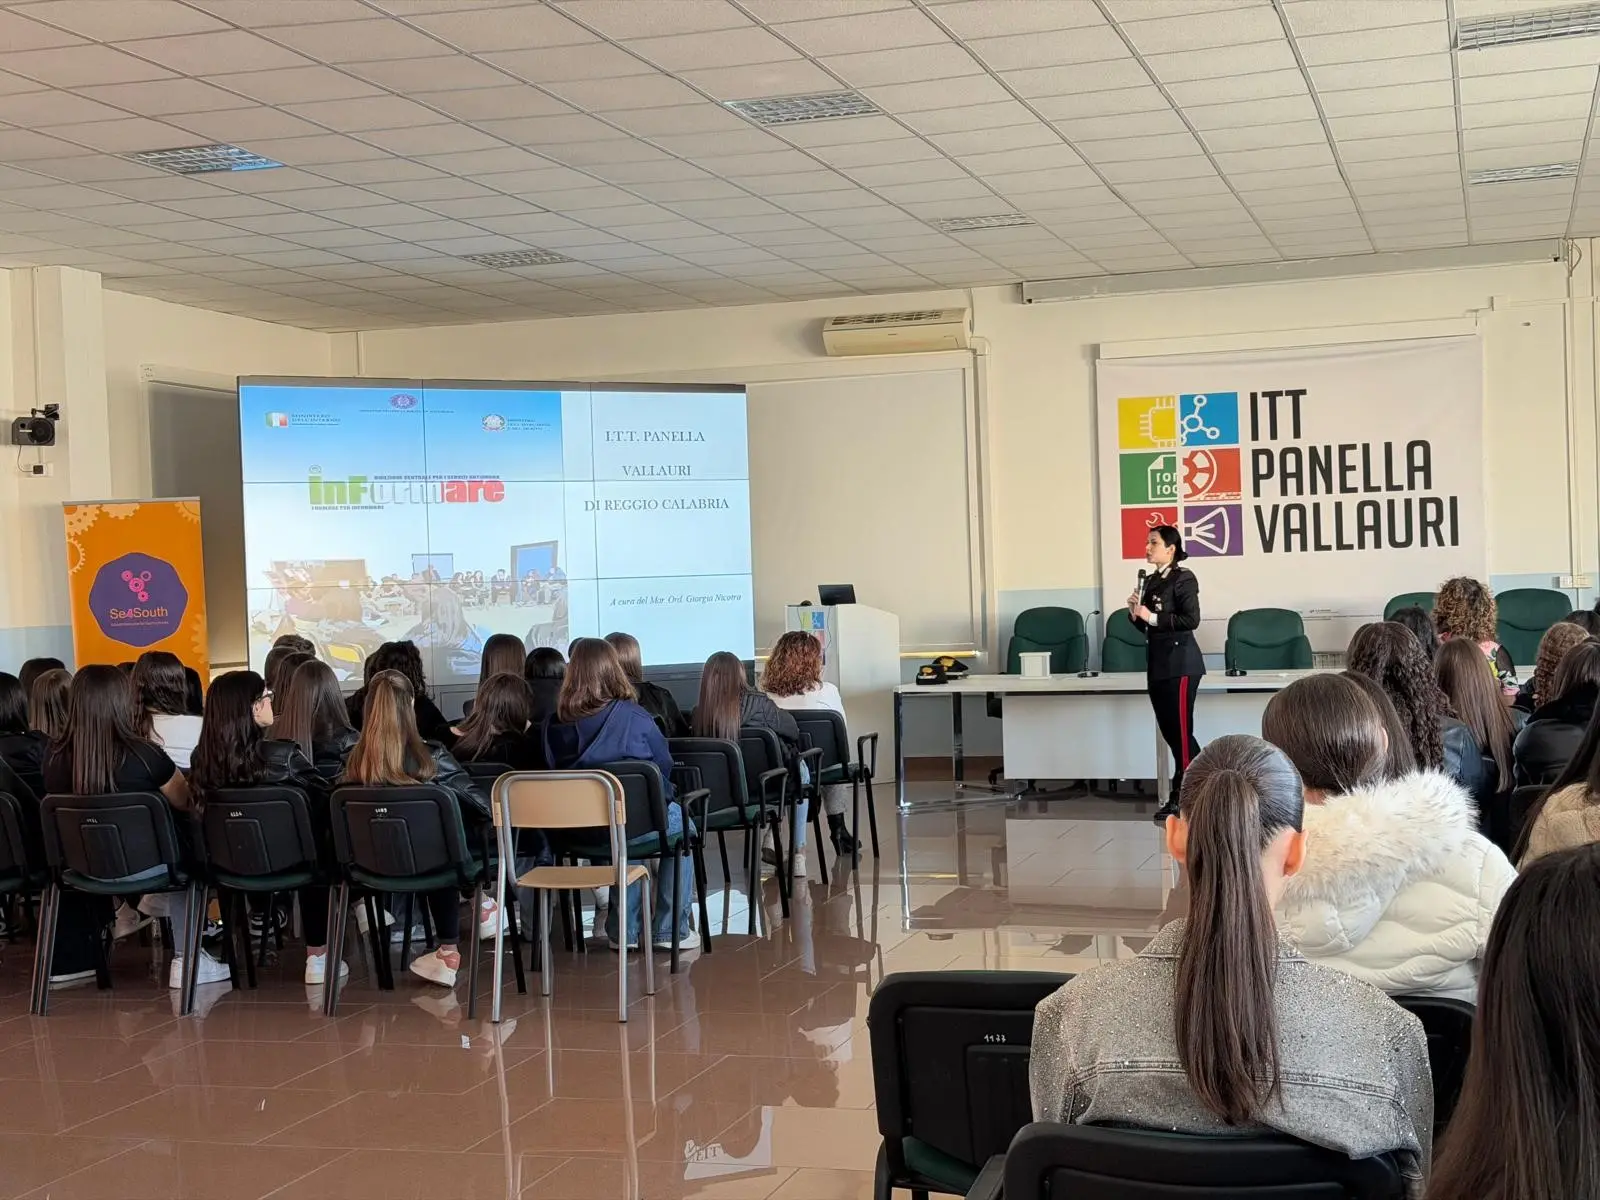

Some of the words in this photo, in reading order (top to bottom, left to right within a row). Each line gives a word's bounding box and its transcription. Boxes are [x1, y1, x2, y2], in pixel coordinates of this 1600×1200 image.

[1249, 389, 1308, 442] ITT
[644, 430, 706, 442] PANELLA
[622, 465, 692, 477] VALLAURI
[1251, 439, 1432, 498] PANELLA
[584, 500, 601, 512] DI
[604, 499, 658, 511] REGGIO
[662, 498, 729, 510] CALABRIA
[1253, 495, 1460, 554] VALLAURI
[636, 596, 648, 605] del
[110, 606, 168, 619] Se4South
